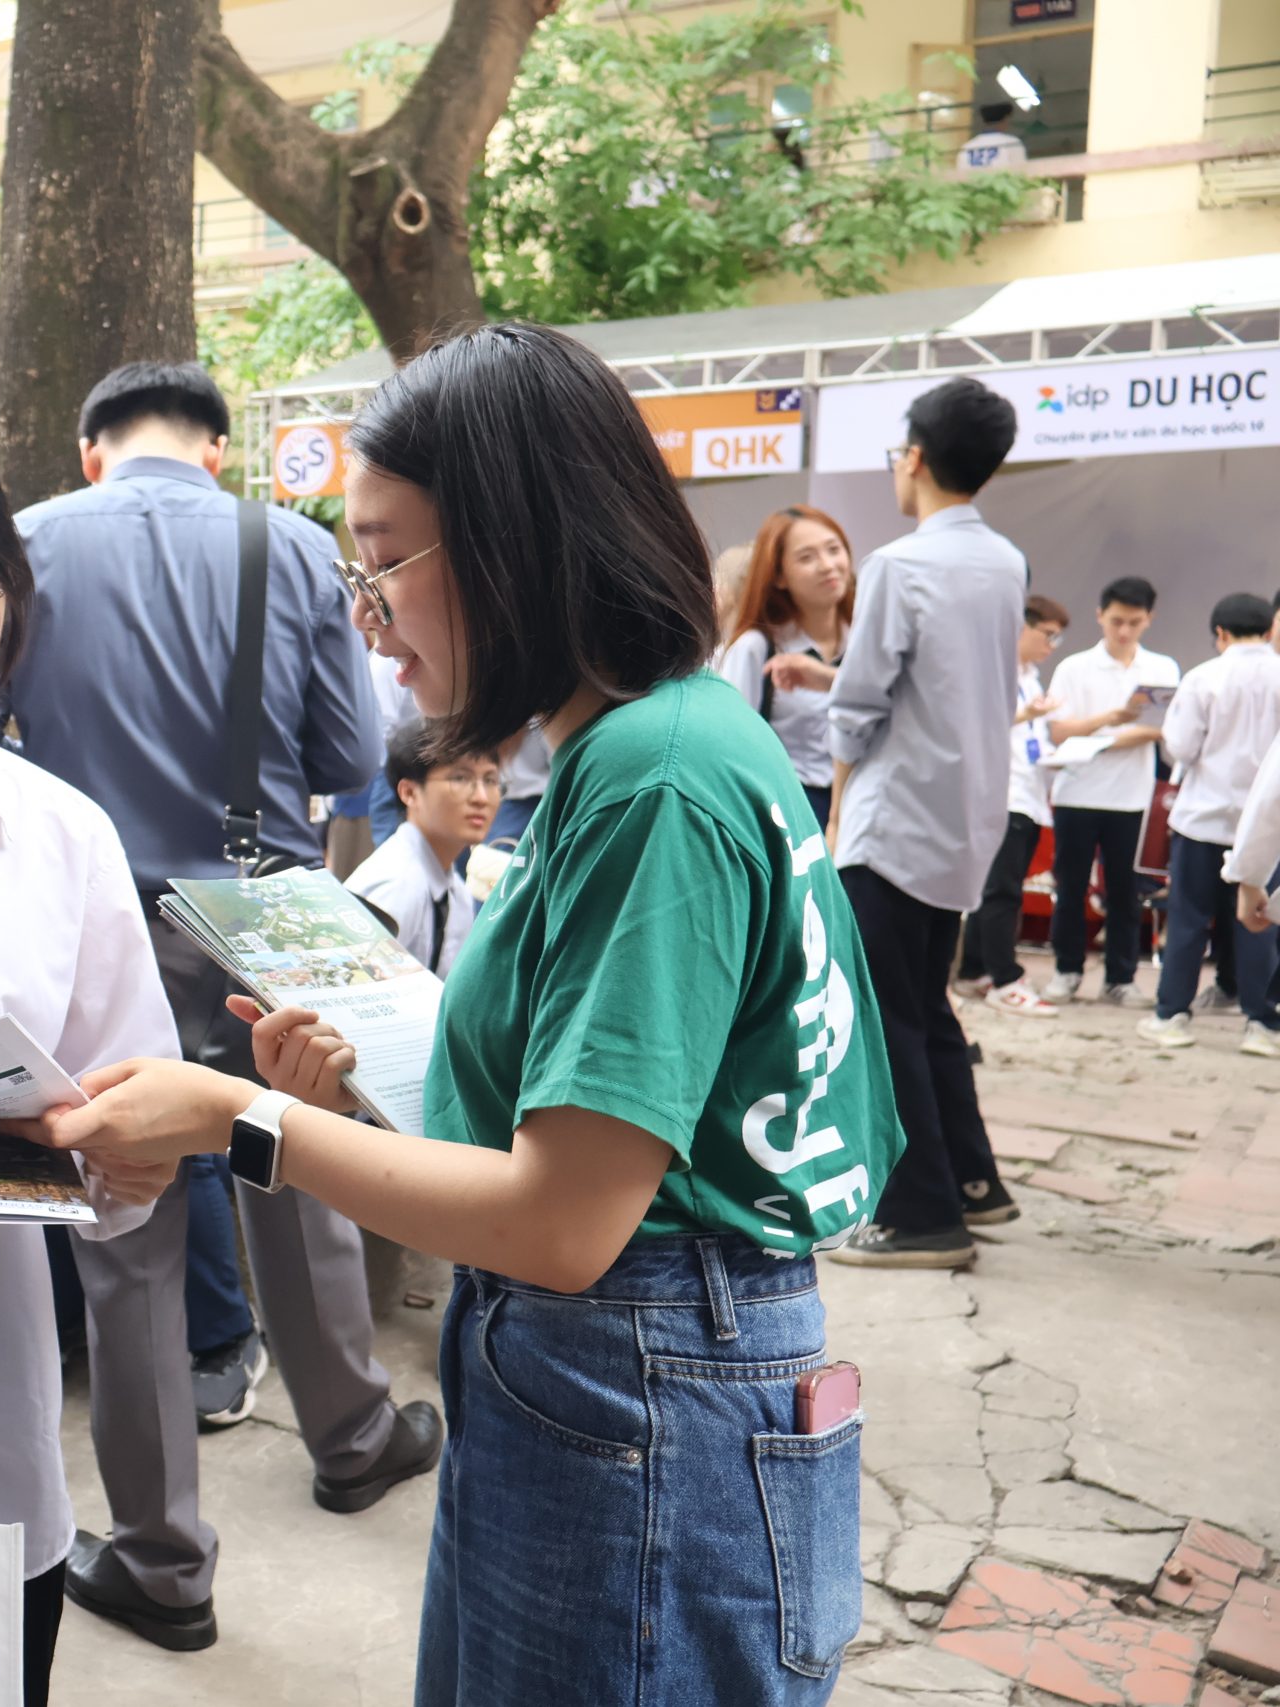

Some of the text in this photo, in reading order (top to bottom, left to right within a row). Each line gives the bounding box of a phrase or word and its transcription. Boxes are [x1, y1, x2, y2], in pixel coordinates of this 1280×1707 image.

[1066, 370, 1268, 412] idp DU HỌC
[705, 432, 785, 470] QHK
